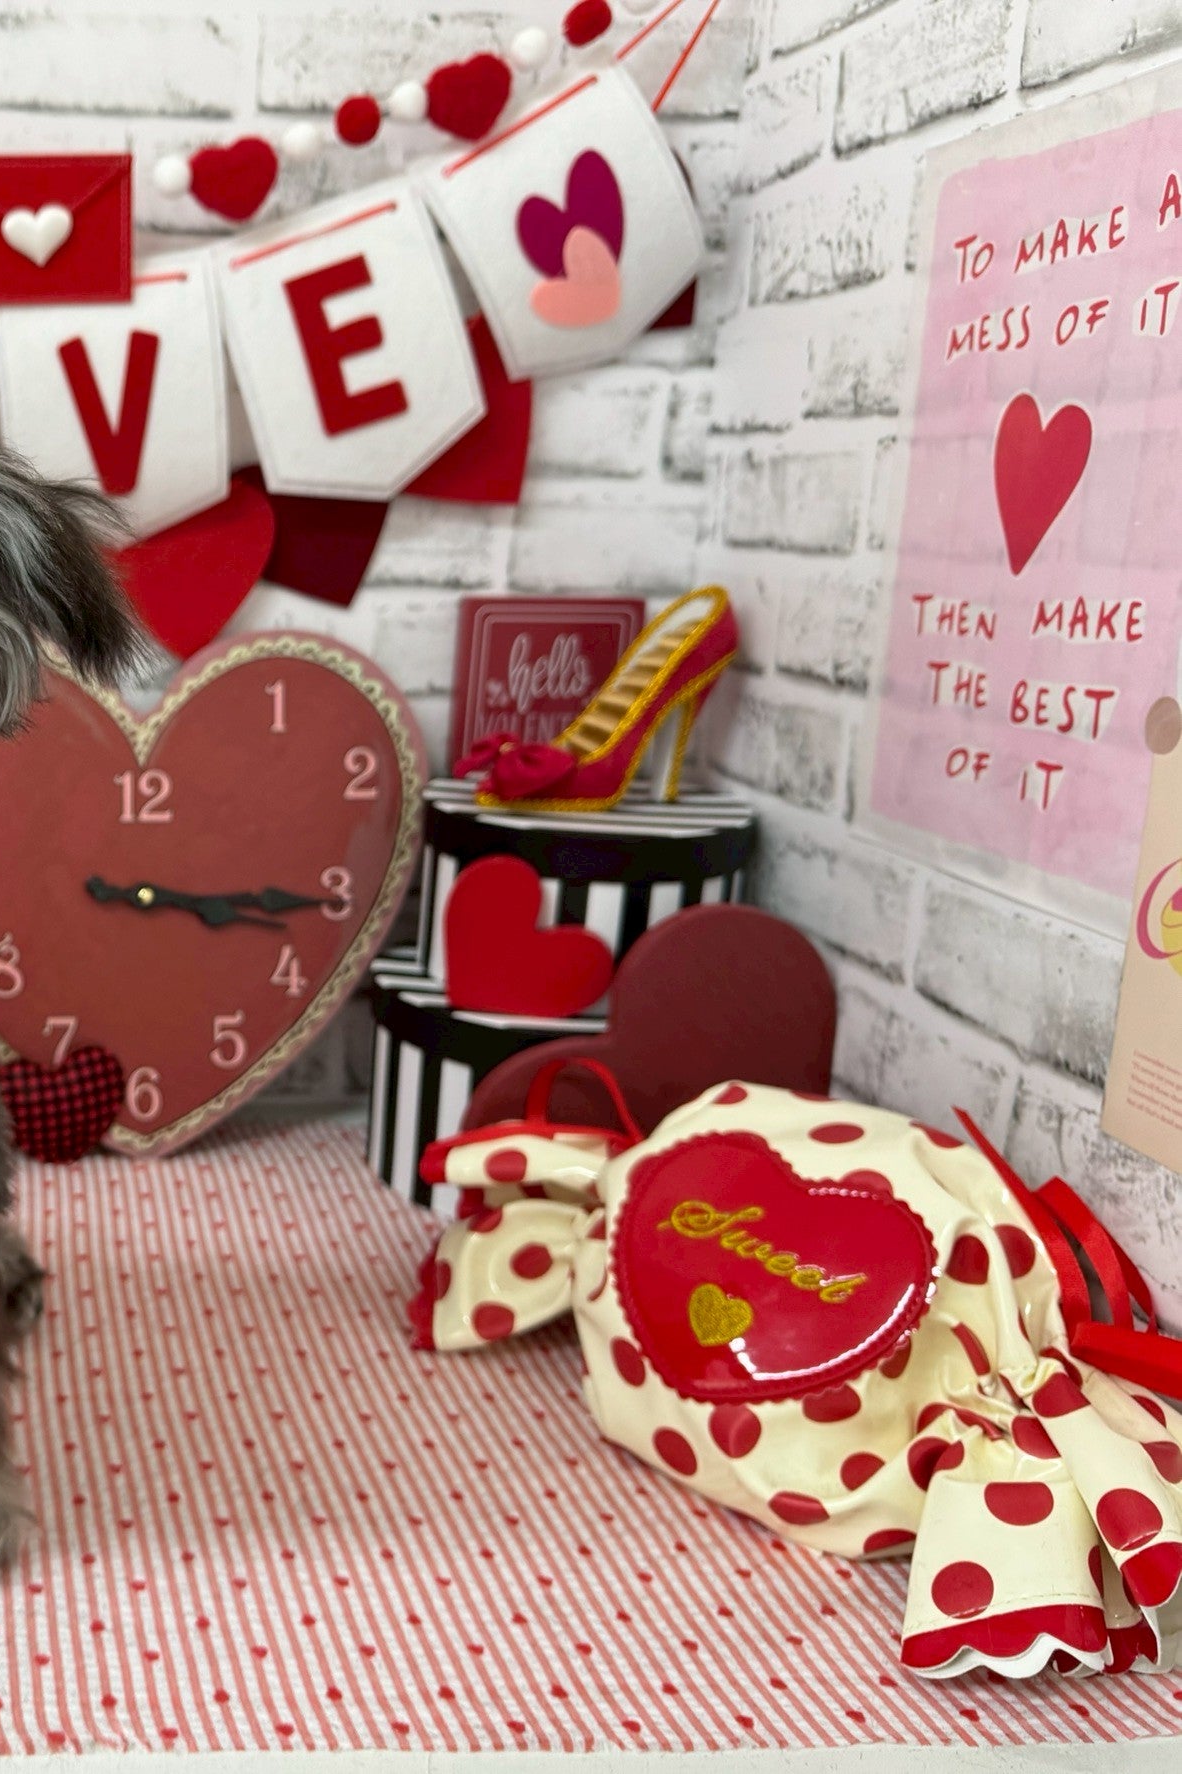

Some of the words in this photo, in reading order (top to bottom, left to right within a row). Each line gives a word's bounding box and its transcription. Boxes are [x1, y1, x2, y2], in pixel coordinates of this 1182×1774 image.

[954, 234, 994, 283] TO
[1014, 206, 1125, 273] MAKE
[1159, 173, 1182, 226] A
[946, 305, 1030, 360] MESS
[1055, 300, 1109, 346] OF
[1139, 281, 1180, 336] IT
[912, 593, 997, 641] THEN
[1031, 596, 1143, 642] MAKE
[264, 680, 287, 733] 1
[927, 661, 987, 709] THE
[1009, 680, 1115, 740] BEST
[113, 769, 174, 824] 12
[343, 746, 378, 800] 2
[945, 747, 990, 782] OF
[1020, 760, 1064, 810] IT
[319, 866, 354, 920] 3
[270, 944, 308, 997] 4
[43, 1016, 79, 1067] 7
[210, 1008, 247, 1069] 5
[125, 1066, 163, 1119] 6
[656, 1200, 869, 1303] Sweet
